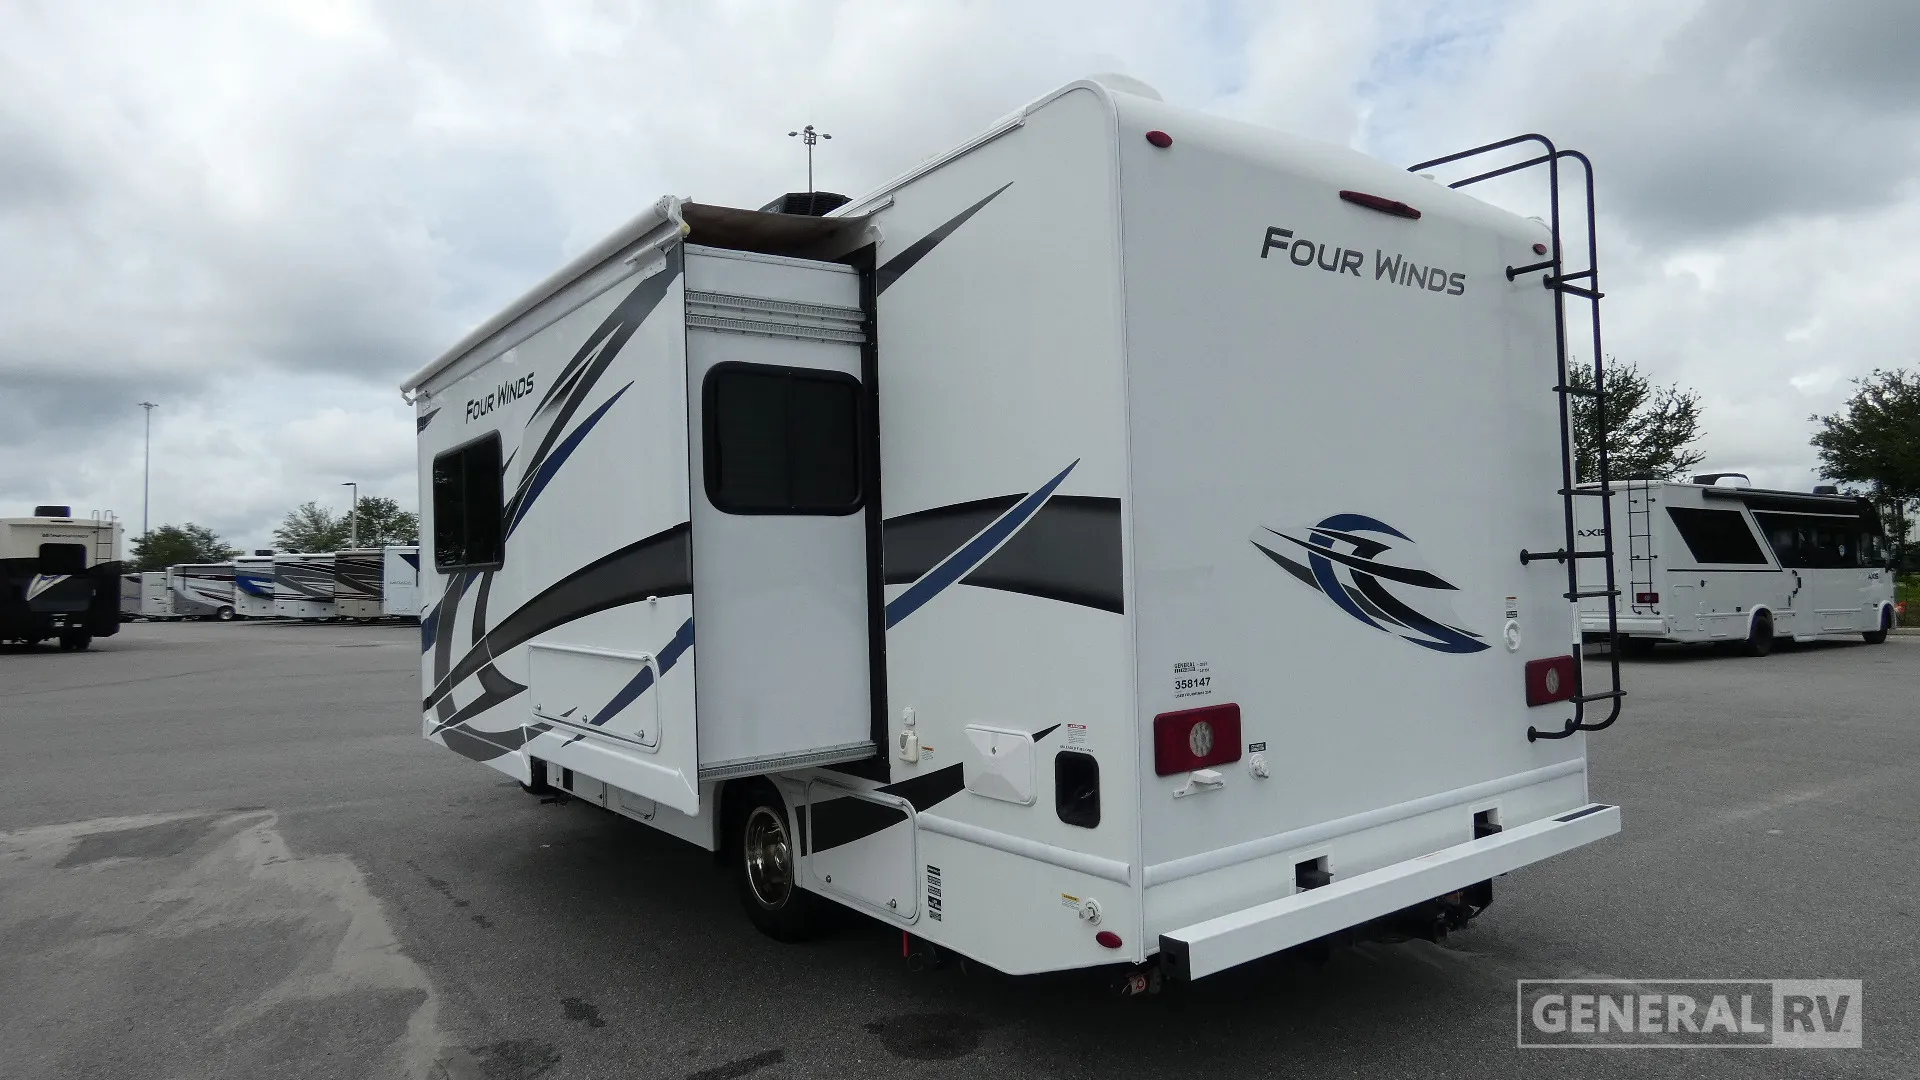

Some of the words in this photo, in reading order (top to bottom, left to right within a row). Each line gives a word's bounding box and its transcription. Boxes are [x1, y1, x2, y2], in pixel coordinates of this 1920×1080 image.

[1261, 226, 1364, 277] FOUR
[1375, 249, 1466, 296] WINDS
[466, 393, 495, 424] FOUR
[497, 371, 534, 408] WINDS
[1175, 677, 1211, 690] 358147
